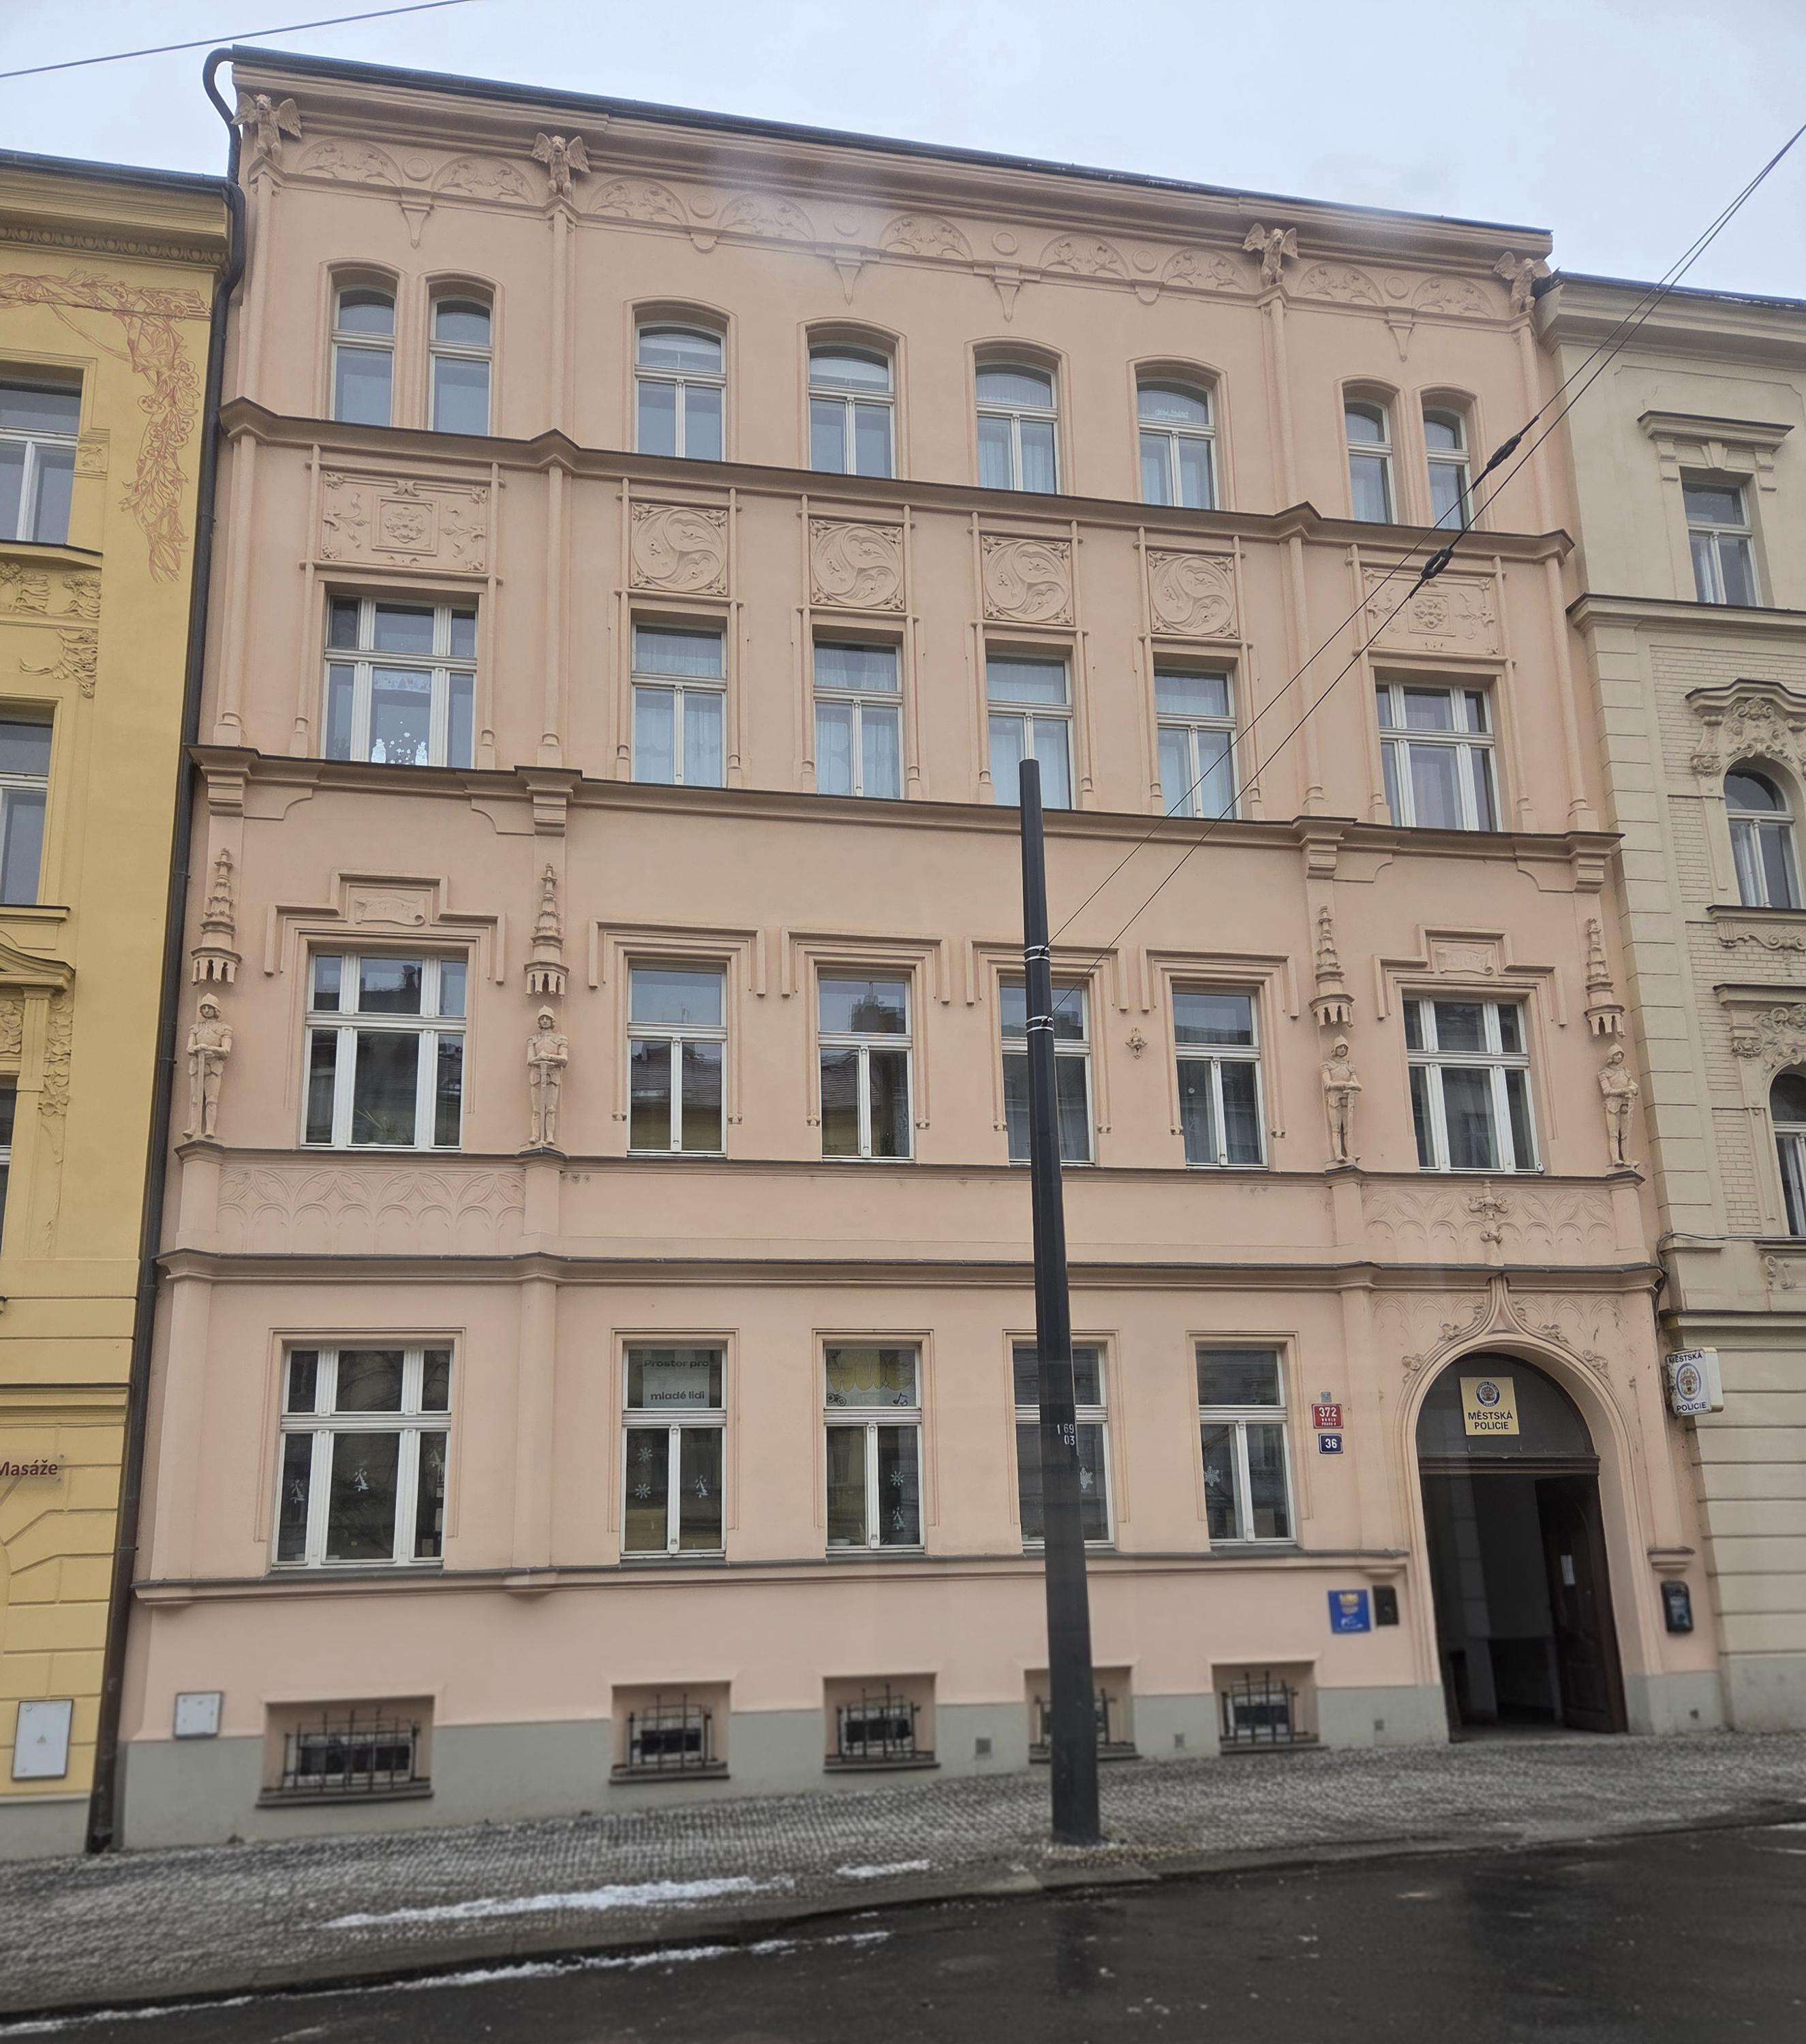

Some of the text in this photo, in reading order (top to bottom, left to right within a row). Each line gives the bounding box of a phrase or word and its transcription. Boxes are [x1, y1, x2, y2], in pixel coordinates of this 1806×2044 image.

[1668, 1352, 1703, 1363] MĚSTSKÁ
[690, 1360, 709, 1369] pro
[650, 1391, 705, 1400] mladé lidi
[1319, 1407, 1337, 1417] 372
[1677, 1402, 1707, 1412] POLICIE
[1467, 1410, 1513, 1421] MĚSTSKÁ
[1057, 1423, 1074, 1435] 1 69
[1474, 1421, 1509, 1430] POLICIE
[1064, 1435, 1075, 1445] 03
[1325, 1438, 1338, 1449] 36
[0, 1459, 58, 1476] Masáže
